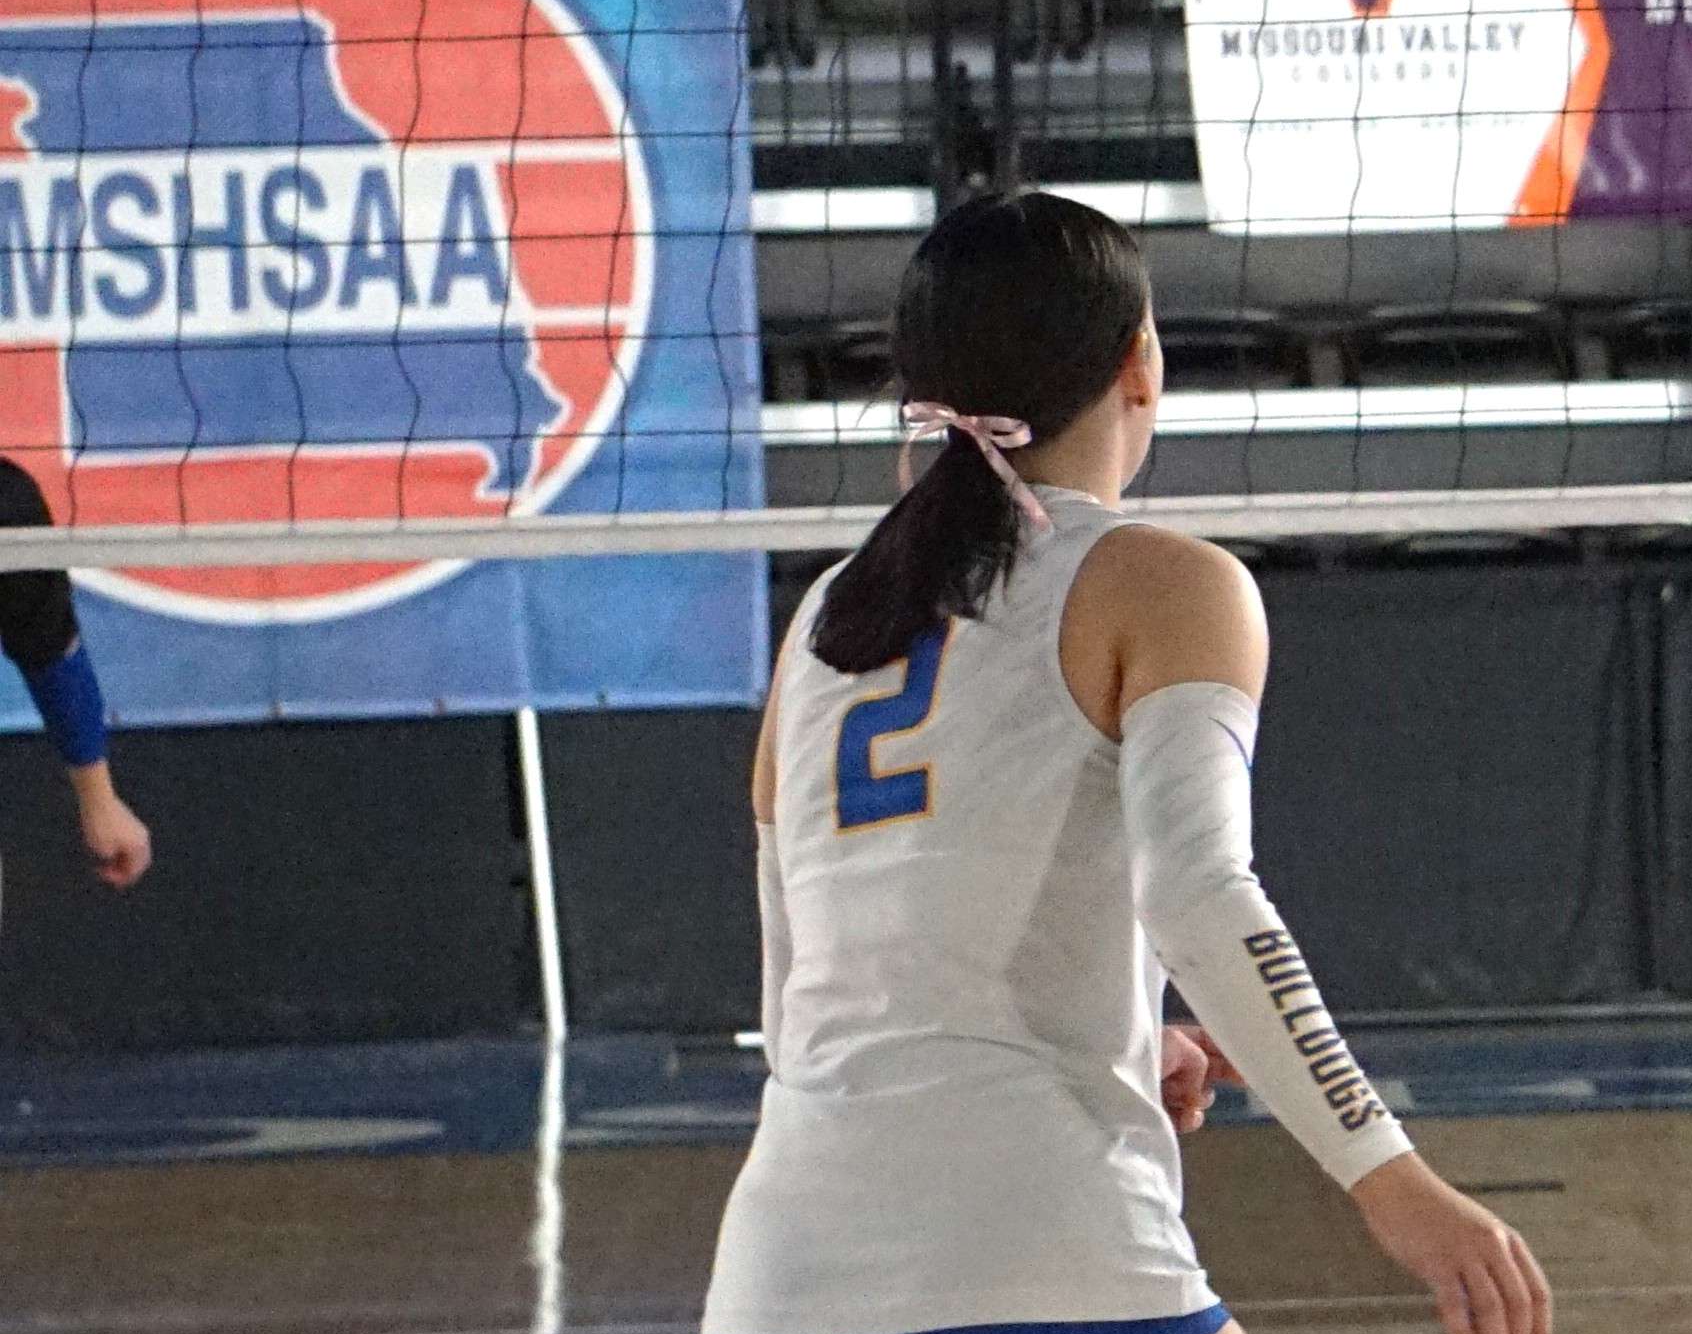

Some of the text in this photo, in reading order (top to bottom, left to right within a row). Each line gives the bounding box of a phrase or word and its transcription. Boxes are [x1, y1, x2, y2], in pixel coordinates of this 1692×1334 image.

[1220, 21, 1526, 58] MISSOURI VALLEY
[0, 162, 511, 323] MSHSAA
[832, 617, 957, 835] 2
[1243, 929, 1387, 1131] BULLDOGS
